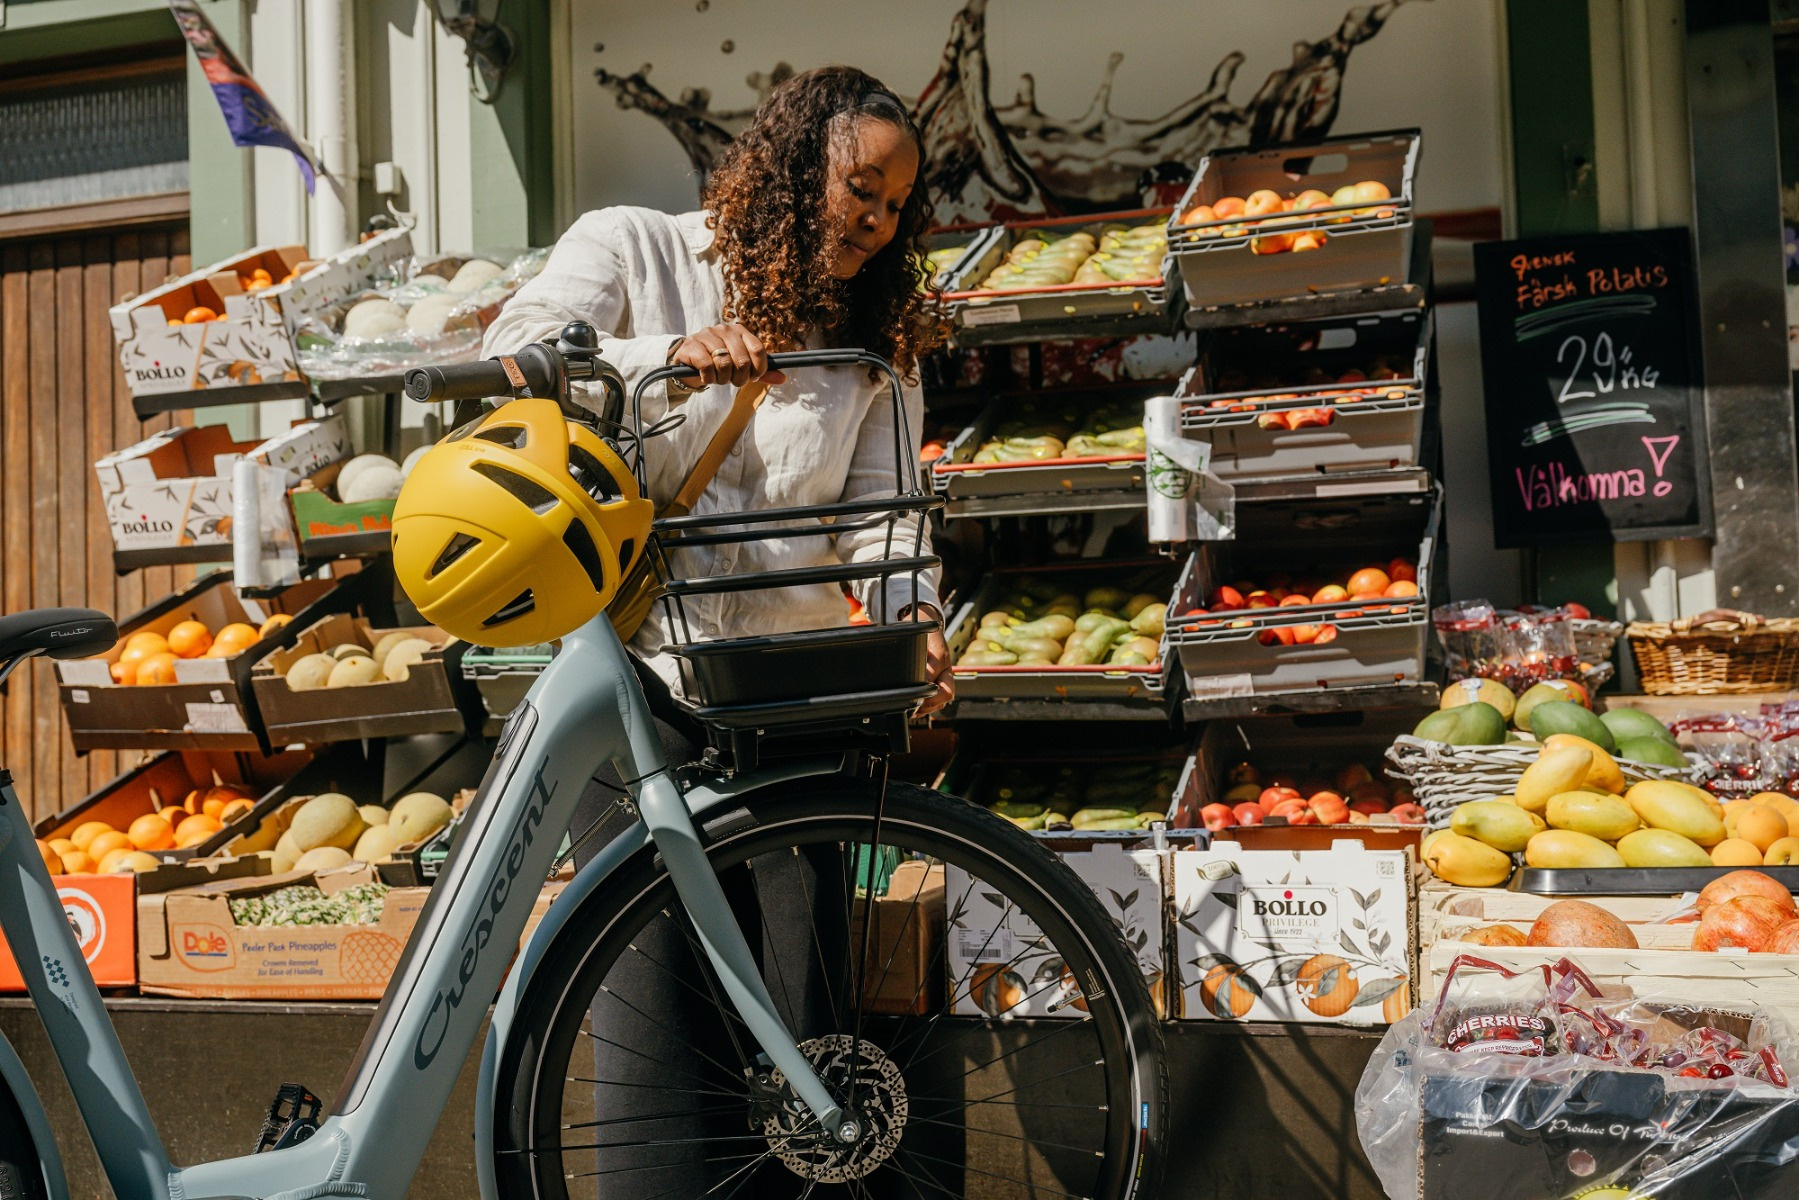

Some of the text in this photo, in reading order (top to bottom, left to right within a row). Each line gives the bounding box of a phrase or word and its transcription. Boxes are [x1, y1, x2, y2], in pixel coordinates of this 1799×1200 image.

[136, 366, 186, 382] BOLLO
[122, 521, 173, 534] BOLLO
[414, 755, 558, 1072] Crescent
[1253, 900, 1327, 916] BOLLO
[1262, 918, 1320, 927] PRIVILEGE
[1290, 928, 1303, 936] 1922
[184, 931, 227, 954] Dole
[288, 940, 338, 953] Pineapples
[288, 959, 319, 967] Removed
[294, 968, 324, 977] Handling
[1447, 1014, 1546, 1045] CHERRIES
[1548, 1119, 1605, 1135] Produce
[1608, 1123, 1630, 1140] Of
